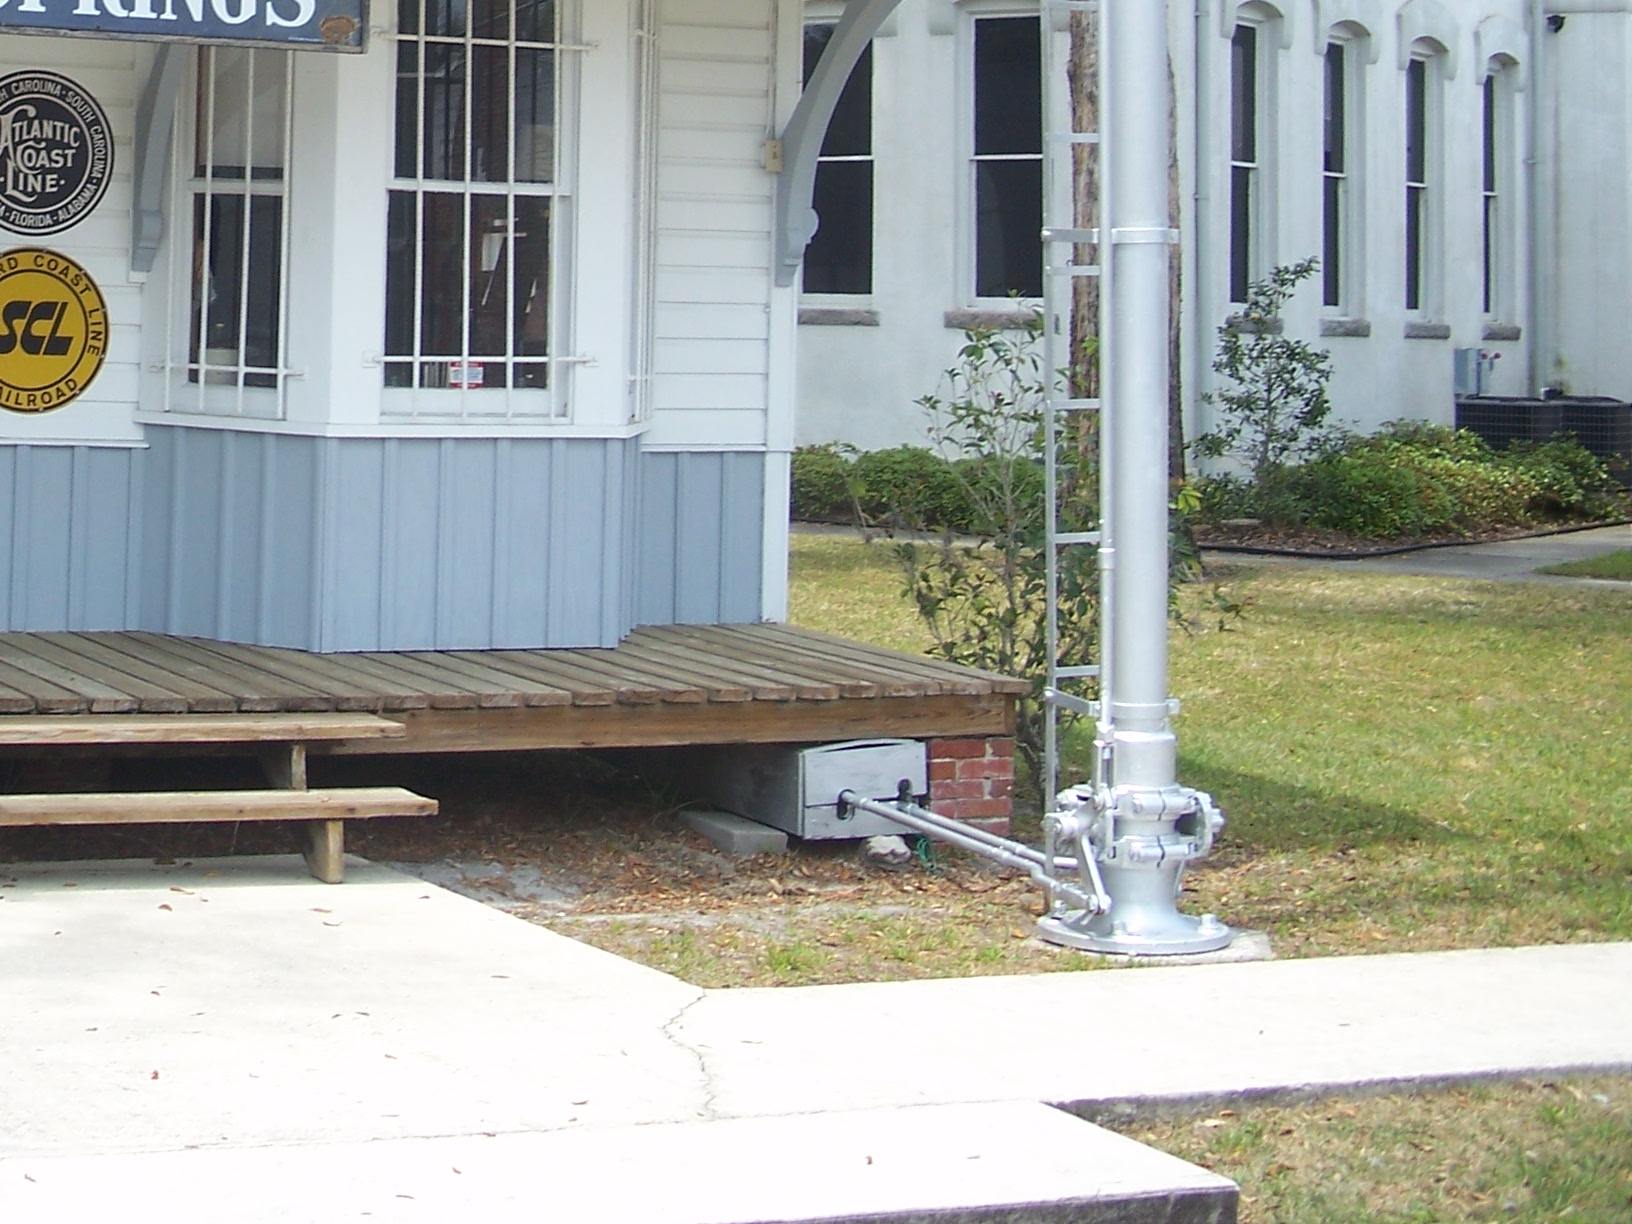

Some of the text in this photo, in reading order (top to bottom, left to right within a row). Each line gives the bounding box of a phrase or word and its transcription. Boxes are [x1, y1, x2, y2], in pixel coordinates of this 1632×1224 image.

[11, 79, 62, 96] CAROLINA
[65, 90, 96, 123] SOUTH
[90, 126, 106, 178] CAROLINA
[16, 140, 77, 174] COAST
[5, 158, 60, 203] LINE
[9, 210, 54, 227] FLORIDA
[58, 183, 98, 222] ALABAMA
[33, 254, 91, 296] COAST
[87, 307, 103, 356] LINE
